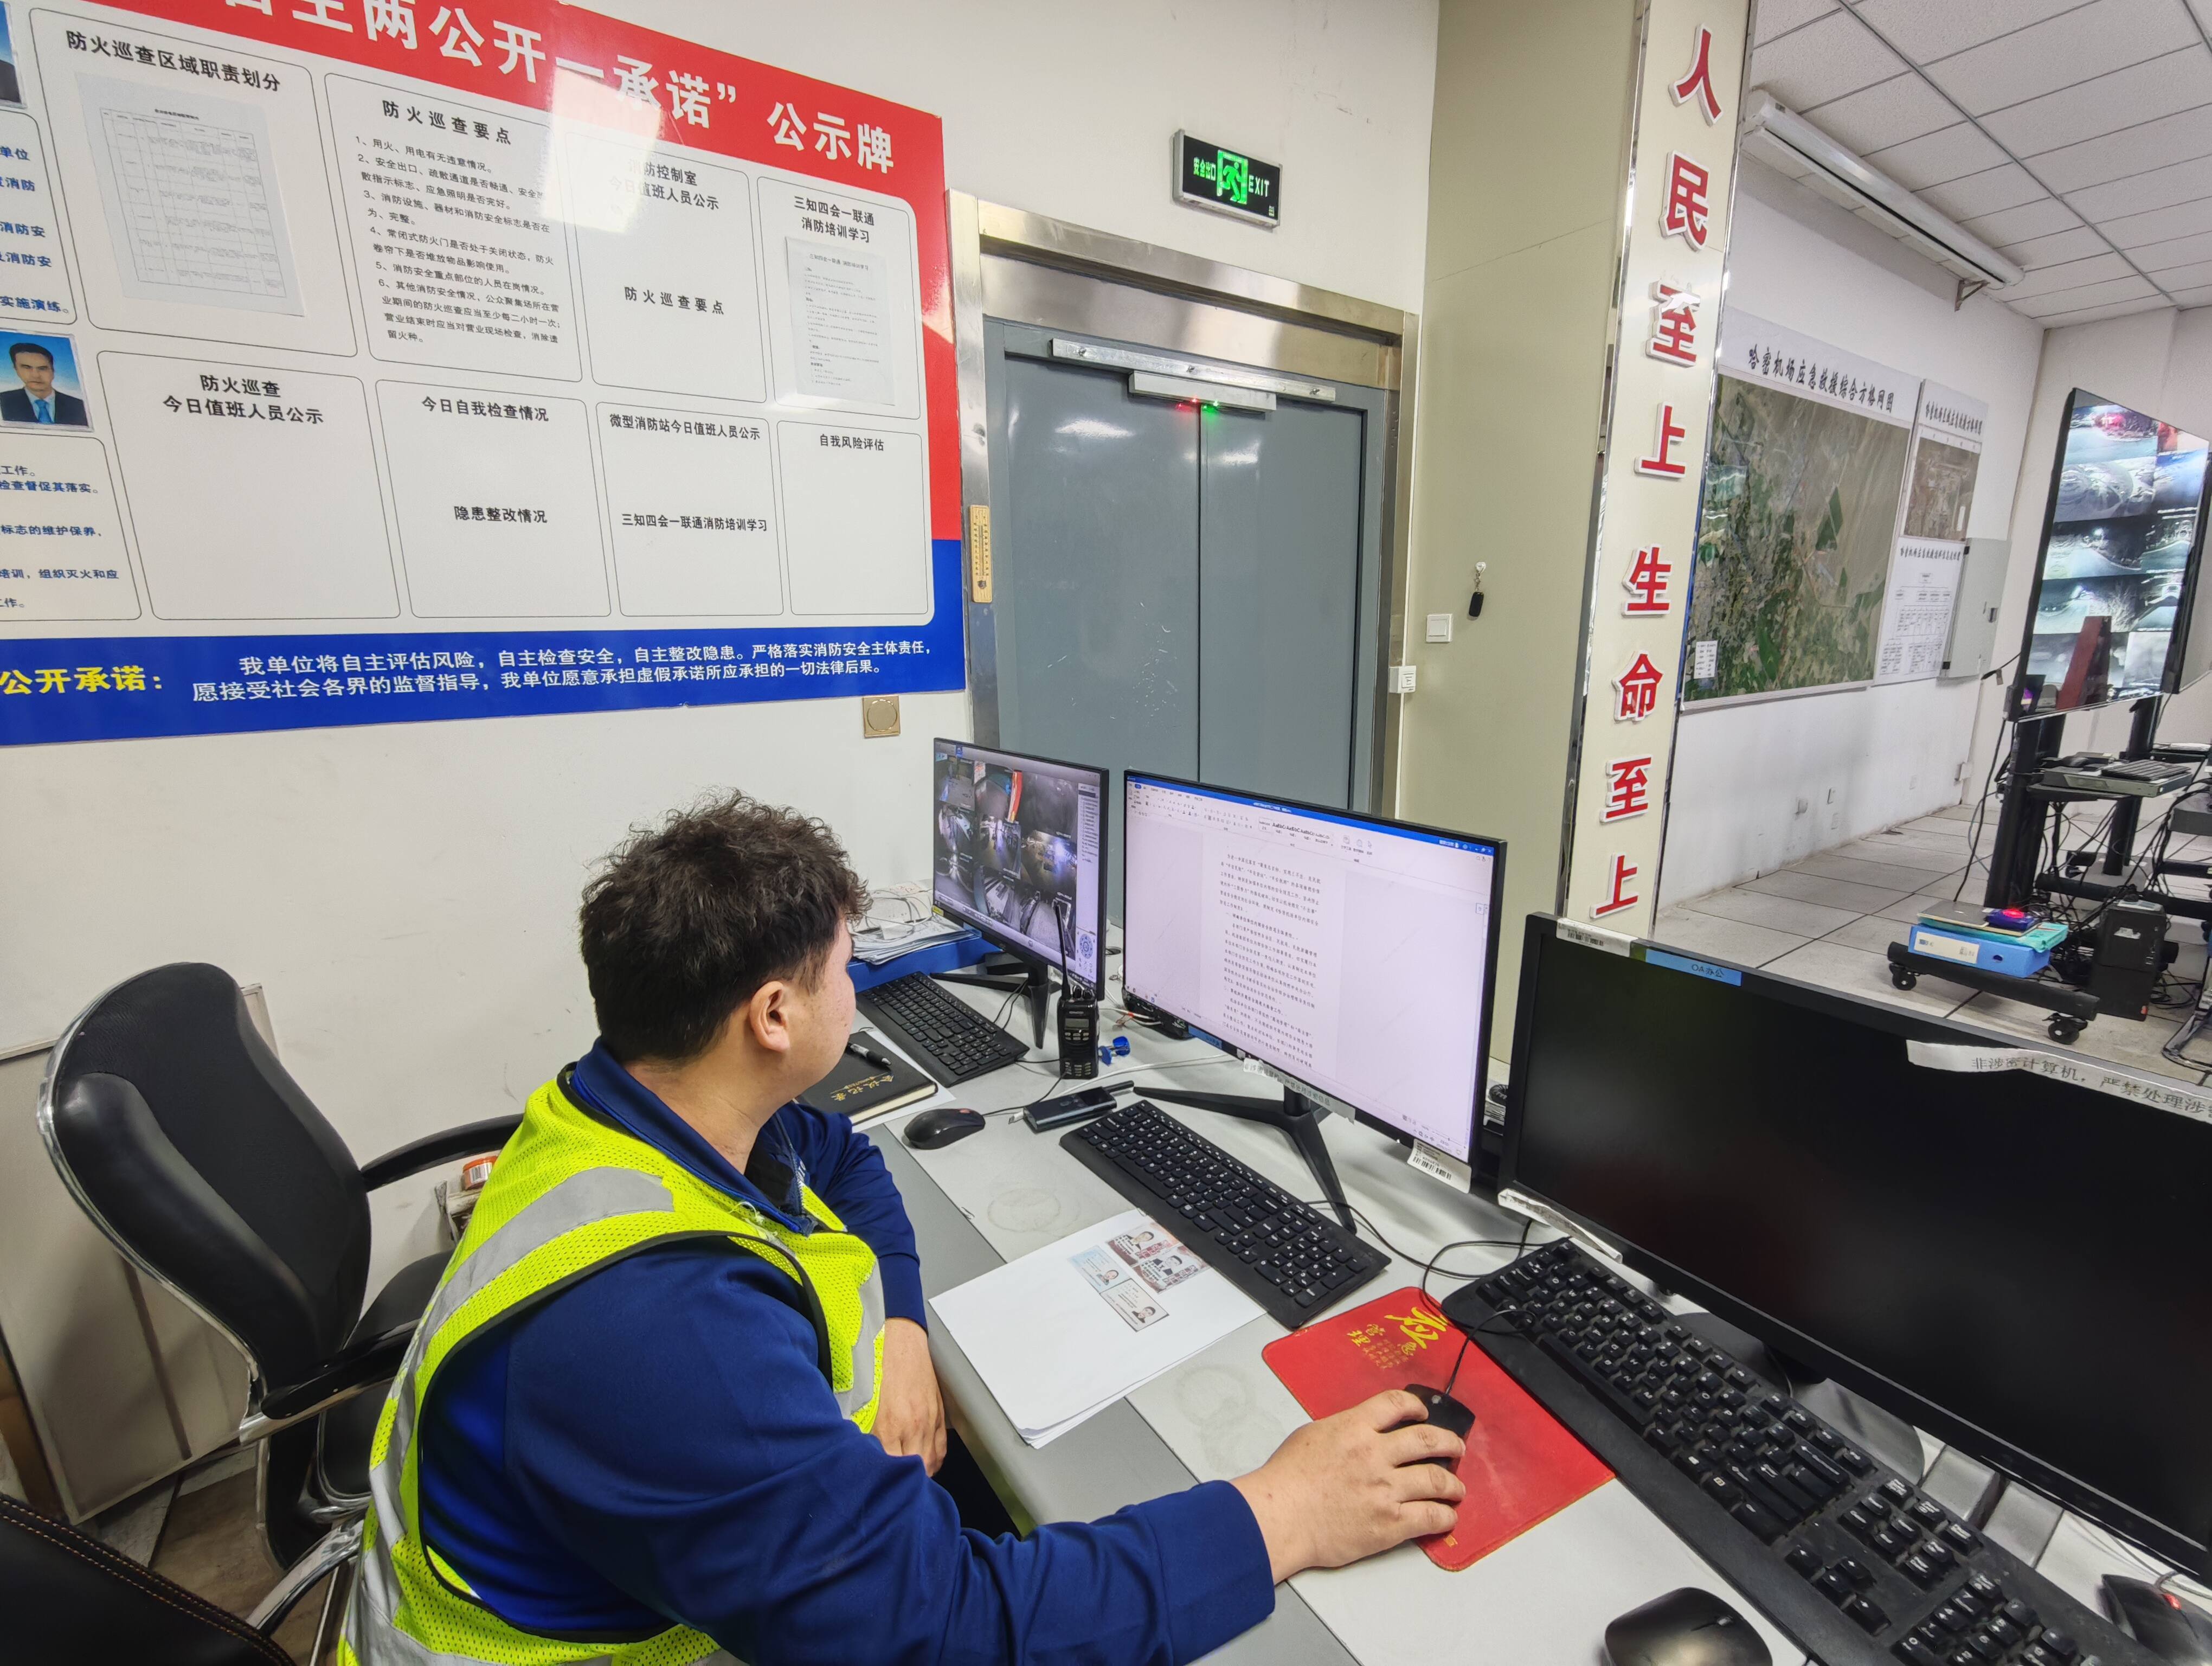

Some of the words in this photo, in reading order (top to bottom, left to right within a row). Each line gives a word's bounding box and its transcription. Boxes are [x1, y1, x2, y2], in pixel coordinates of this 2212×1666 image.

[66, 30, 281, 92] 防火巡查区域职责划分
[382, 100, 512, 145] 防火巡查要点
[766, 101, 895, 175] 公示牌
[1193, 157, 1216, 182] 安全出口
[608, 175, 720, 211] 今日值班人员公示
[1249, 174, 1270, 197] EXIT
[794, 195, 875, 227] 三知四会一联通
[801, 216, 871, 244] 消防培训学习
[1634, 23, 1723, 479] 人民至上
[0, 296, 70, 315] 实施演练。
[623, 286, 725, 316] 防火巡查要点
[387, 330, 425, 343] 留火种。
[200, 374, 281, 398] 防火巡查
[162, 395, 324, 425] 今日值班人员公示
[421, 396, 550, 422] 今日自我检查情况
[609, 413, 761, 440] 微型消防站今日值班人员公示
[819, 433, 885, 452] 自我风险评估
[454, 505, 548, 524] 隐患整改情况
[621, 513, 768, 532] 三知四会一联通消防培训学习
[239, 640, 931, 676] 我单位将自主评估风险，自主检查安全，自主整改隐患。严格落实消防安全主体责任，
[192, 660, 880, 702] 愿接受社会各界的监督指导，我单位愿意承担虚假承诺所应承担的一切法律后果。
[1590, 543, 1672, 920] 生命至上
[1971, 1057, 2212, 1119] 非涉密计算机，严禁处理涉
